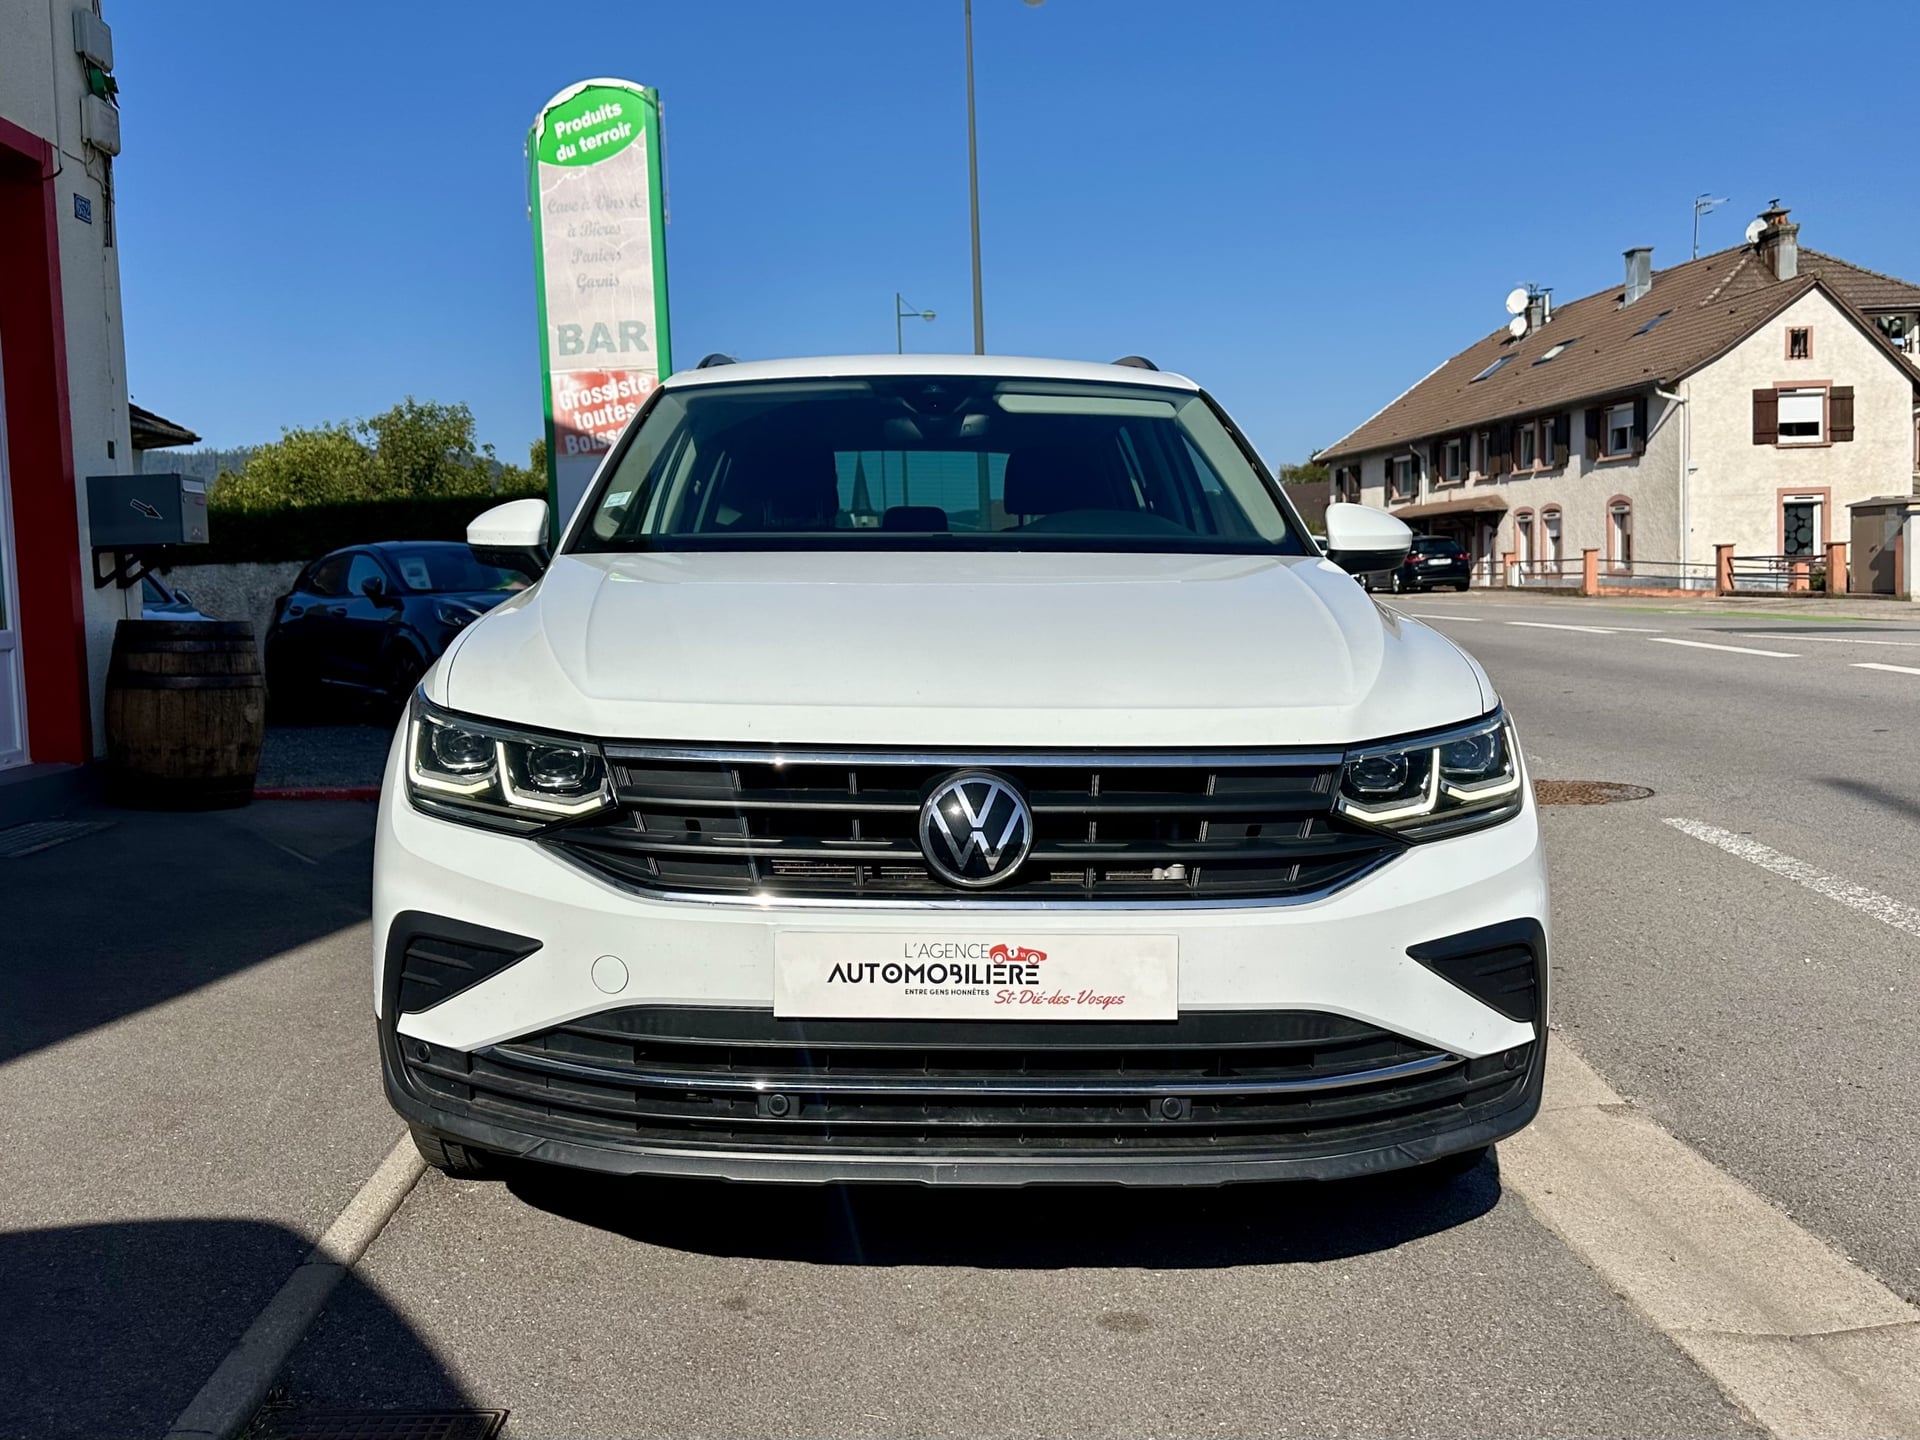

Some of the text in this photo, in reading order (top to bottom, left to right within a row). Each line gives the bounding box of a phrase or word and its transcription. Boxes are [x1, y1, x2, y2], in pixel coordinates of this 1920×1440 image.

[554, 103, 622, 139] Produits
[555, 121, 632, 162] du terroir
[546, 197, 578, 214] Cave
[567, 222, 576, 237] à
[571, 247, 622, 264] Paniers
[576, 273, 620, 293] Garnis
[557, 320, 649, 356] BAR
[559, 374, 650, 411] Grossiste
[574, 401, 637, 430] toutes
[565, 426, 623, 456] Boiss
[904, 943, 990, 959] L'AGENCE
[904, 987, 990, 996] ENTRE GENS HONNÊTES
[994, 989, 1126, 1010] St-Dié-des-Vosges
